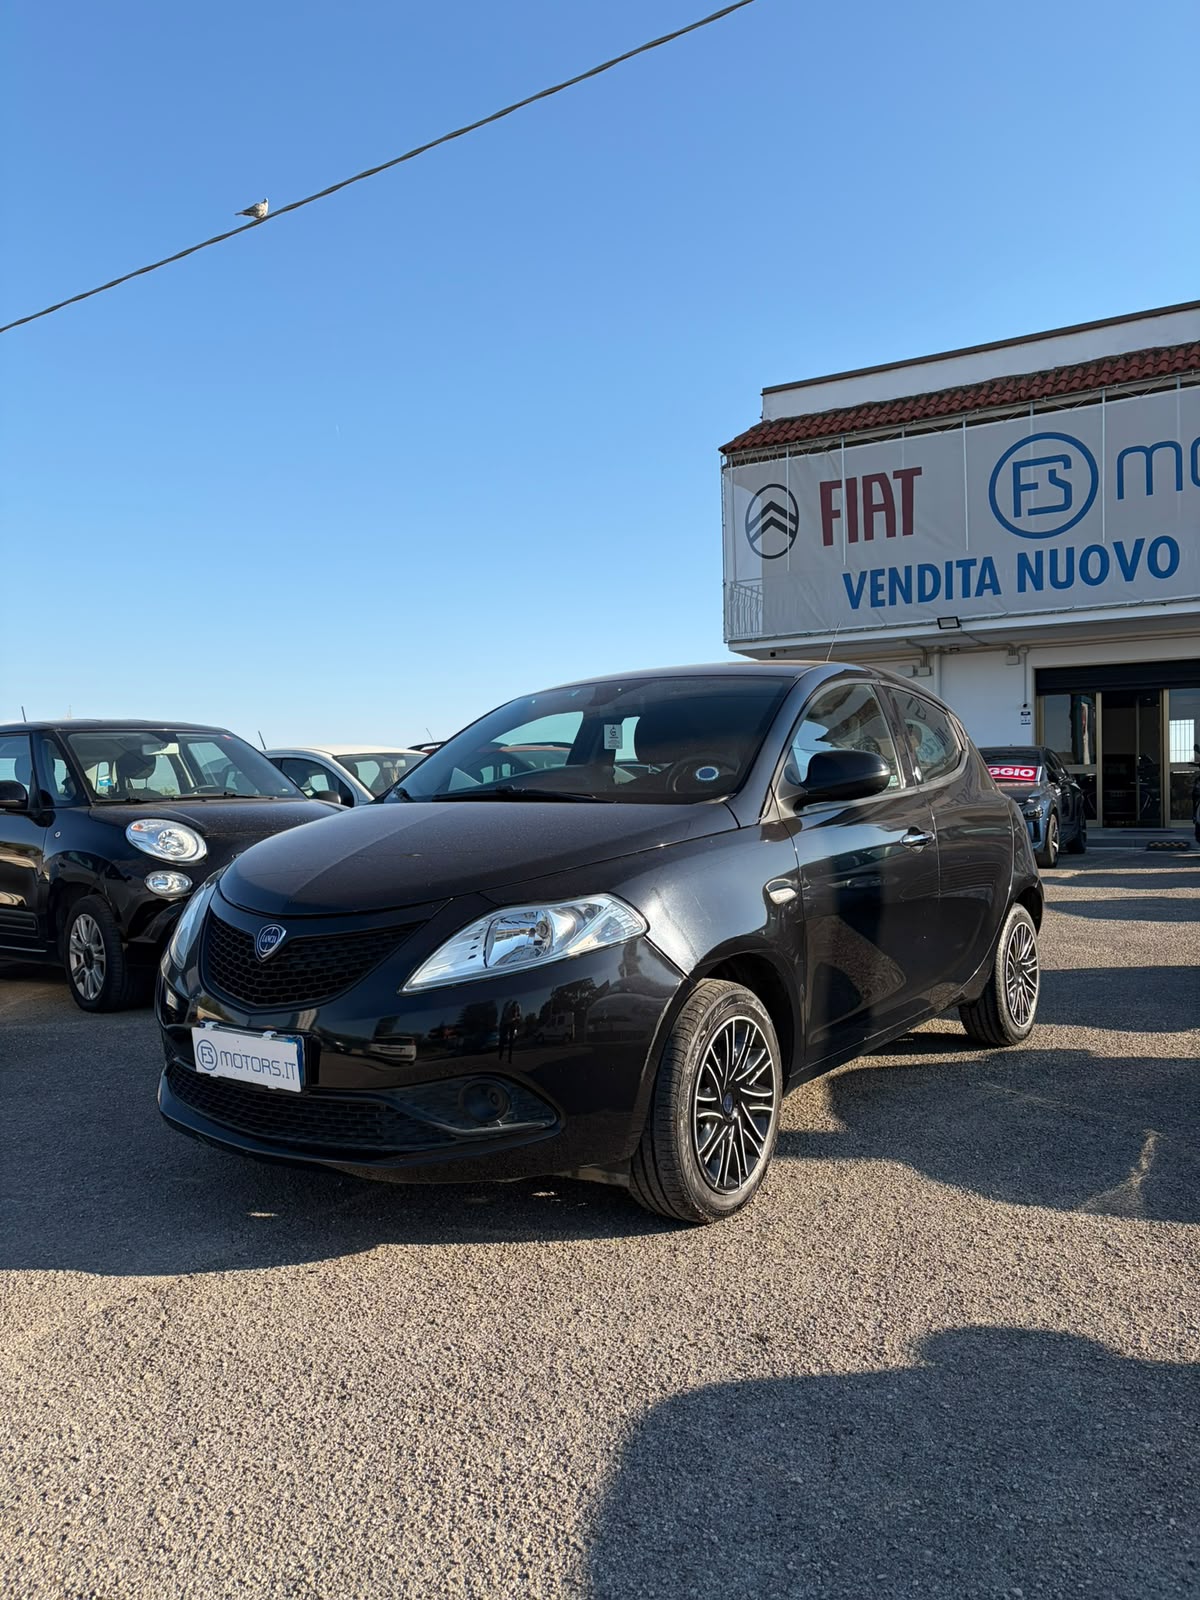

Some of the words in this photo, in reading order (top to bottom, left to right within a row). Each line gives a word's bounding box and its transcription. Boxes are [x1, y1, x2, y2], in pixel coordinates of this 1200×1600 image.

[819, 466, 922, 547] FIAT
[1012, 453, 1072, 518] FS
[1116, 436, 1200, 501] M
[842, 556, 1002, 610] VENDITA
[1017, 535, 1180, 593] NUOVO
[219, 1050, 296, 1081] MOTORS.IT
